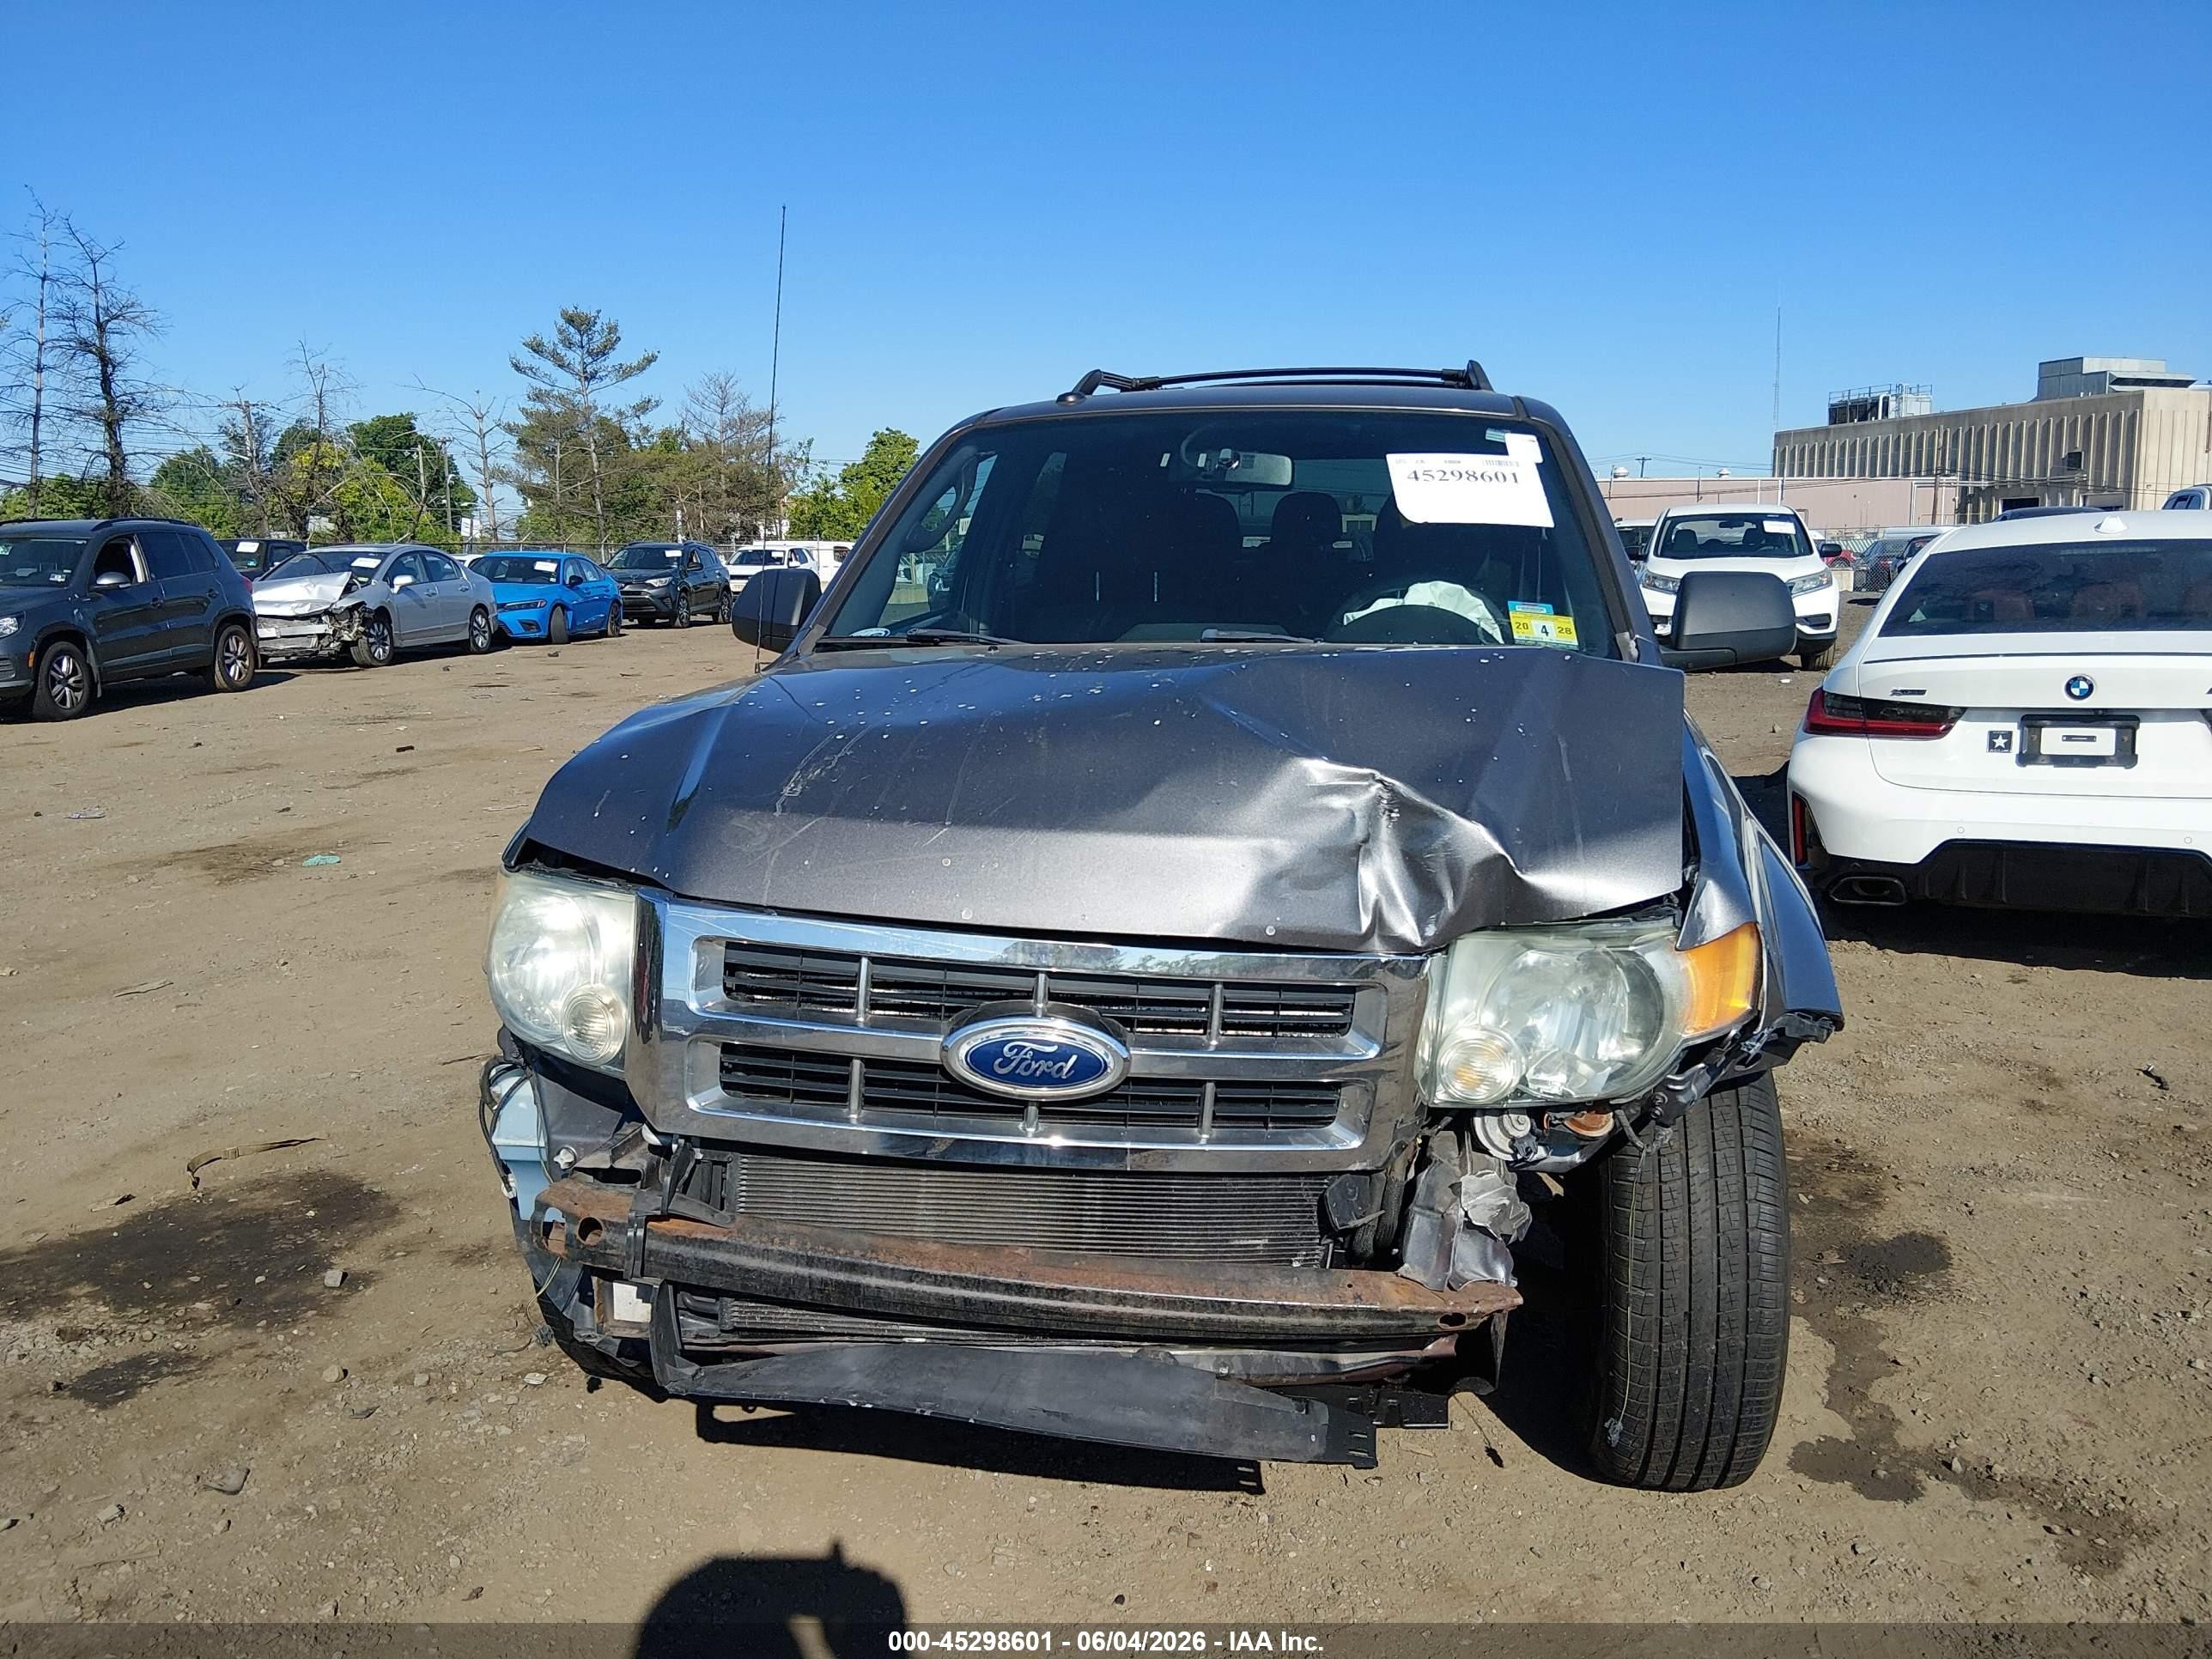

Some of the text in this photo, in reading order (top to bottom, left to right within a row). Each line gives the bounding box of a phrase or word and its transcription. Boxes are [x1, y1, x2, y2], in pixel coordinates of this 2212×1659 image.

[1407, 469, 1519, 484] 45298601
[1515, 622, 1572, 637] 20 4 28
[993, 1041, 1079, 1079] Ford
